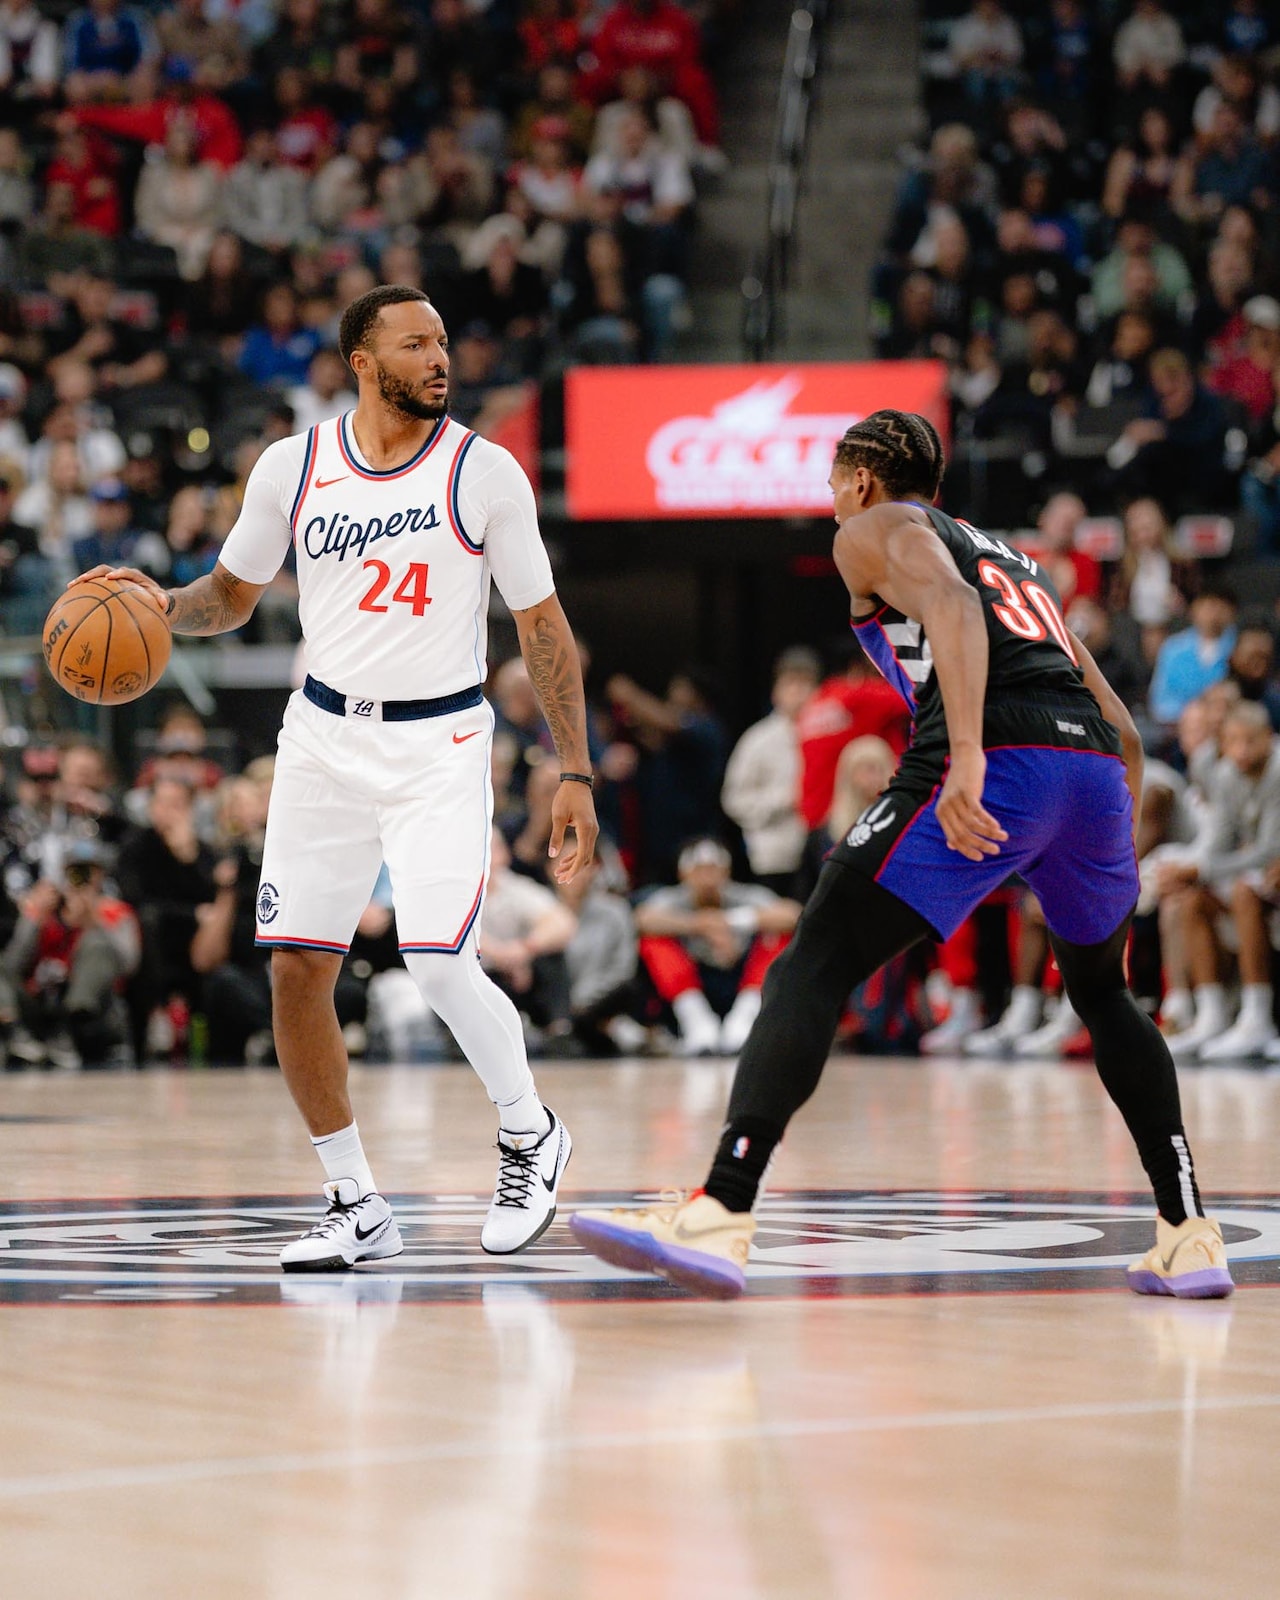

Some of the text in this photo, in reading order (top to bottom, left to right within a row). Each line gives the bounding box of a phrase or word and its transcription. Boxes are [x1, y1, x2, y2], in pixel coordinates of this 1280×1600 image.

[304, 503, 441, 561] Clippers
[358, 559, 432, 616] 24
[978, 559, 1079, 668] 30
